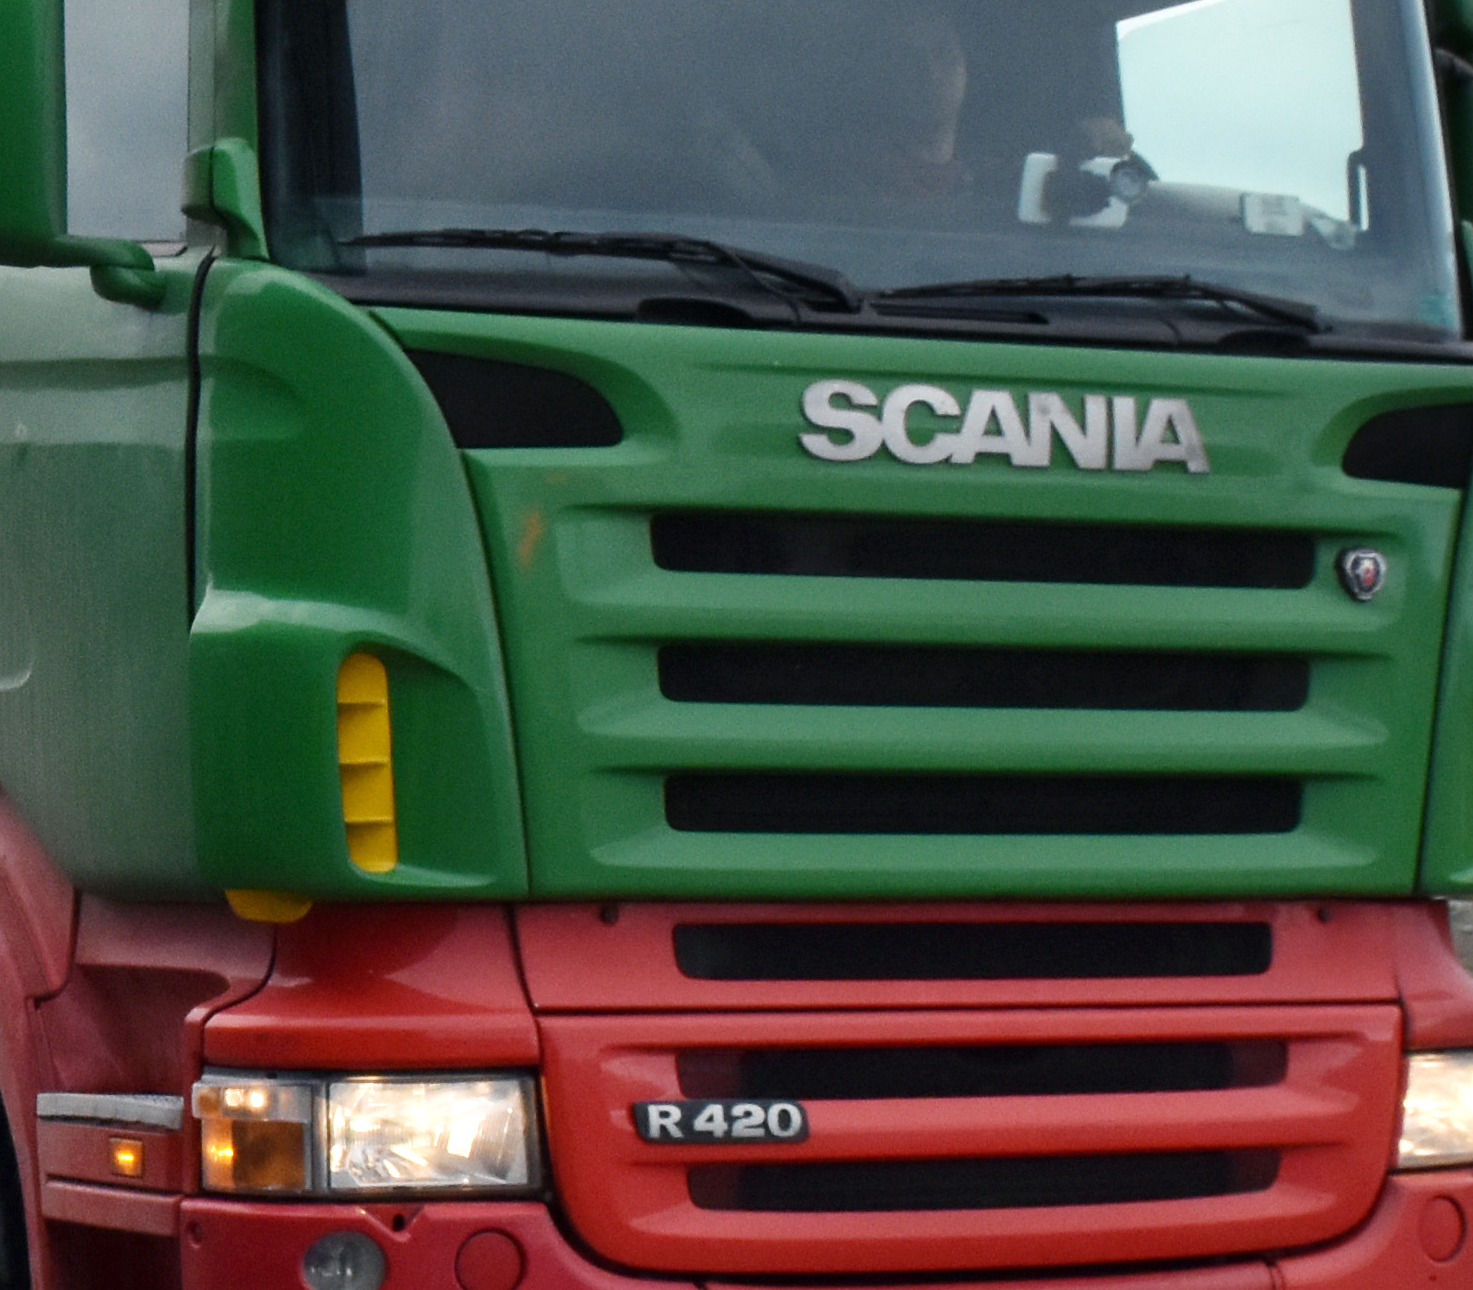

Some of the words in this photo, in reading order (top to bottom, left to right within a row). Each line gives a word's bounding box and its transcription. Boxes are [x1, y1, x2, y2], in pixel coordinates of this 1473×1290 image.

[798, 378, 1211, 474] SCANIA
[647, 1103, 684, 1139] R
[692, 1102, 803, 1139] 420
